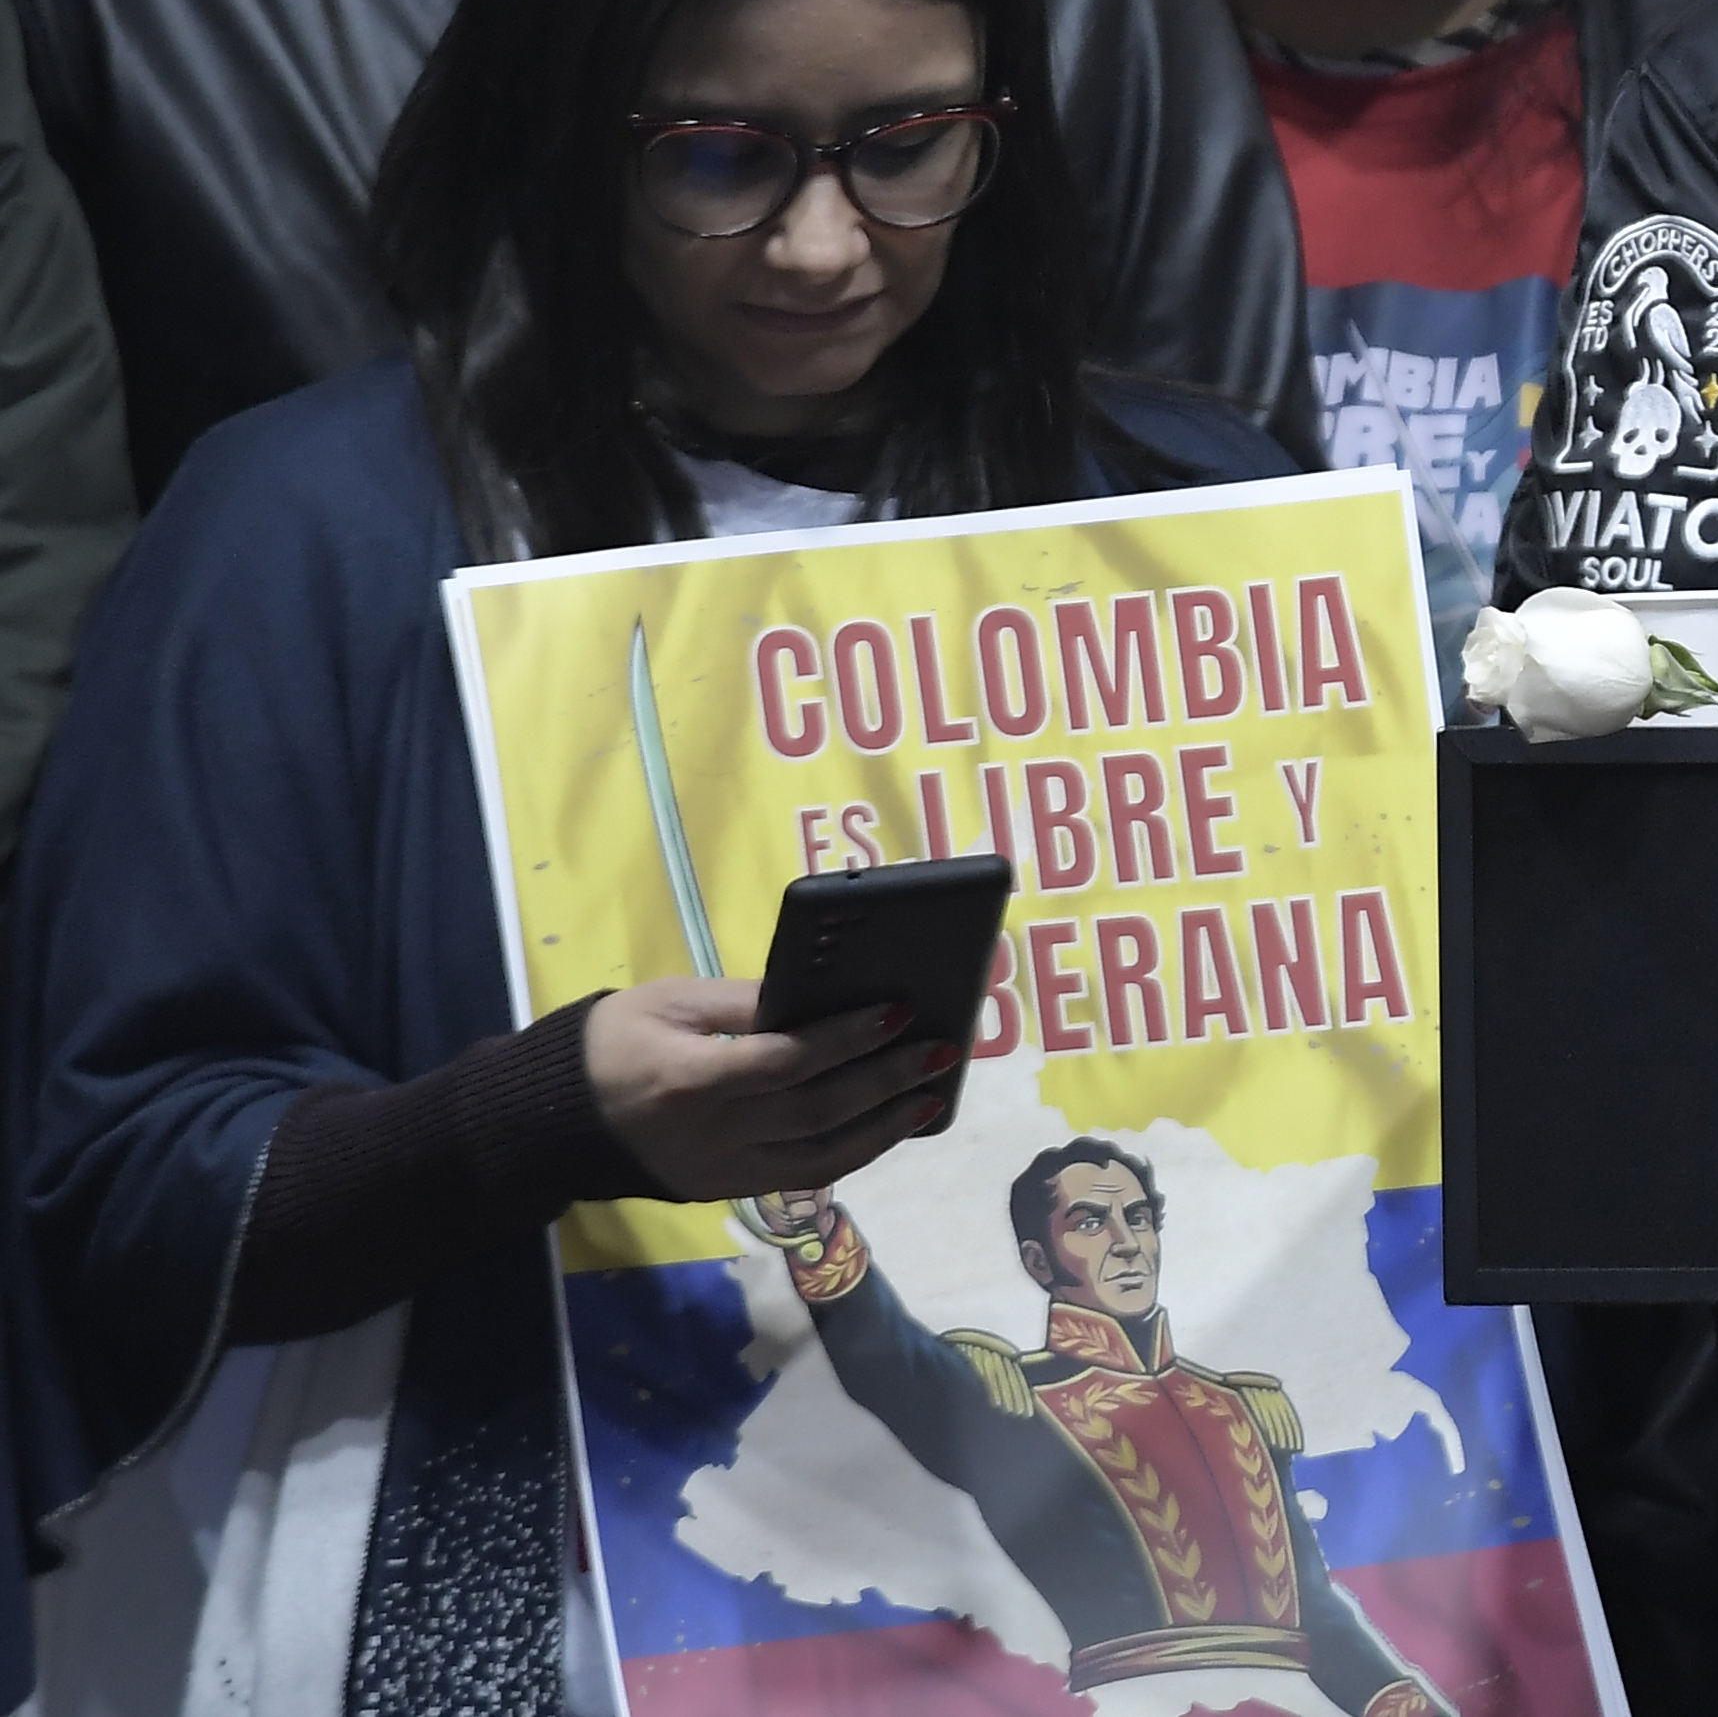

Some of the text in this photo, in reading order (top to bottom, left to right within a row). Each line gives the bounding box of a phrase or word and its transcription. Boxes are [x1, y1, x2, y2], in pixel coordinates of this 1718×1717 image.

[1587, 299, 1615, 326] ES
[1313, 347, 1502, 411] MBIA
[1580, 555, 1674, 592] SOUL
[756, 576, 1366, 760] COLOMBIA
[798, 801, 877, 876] ES
[1281, 758, 1322, 849] Y
[968, 892, 1407, 1062] BERANA
